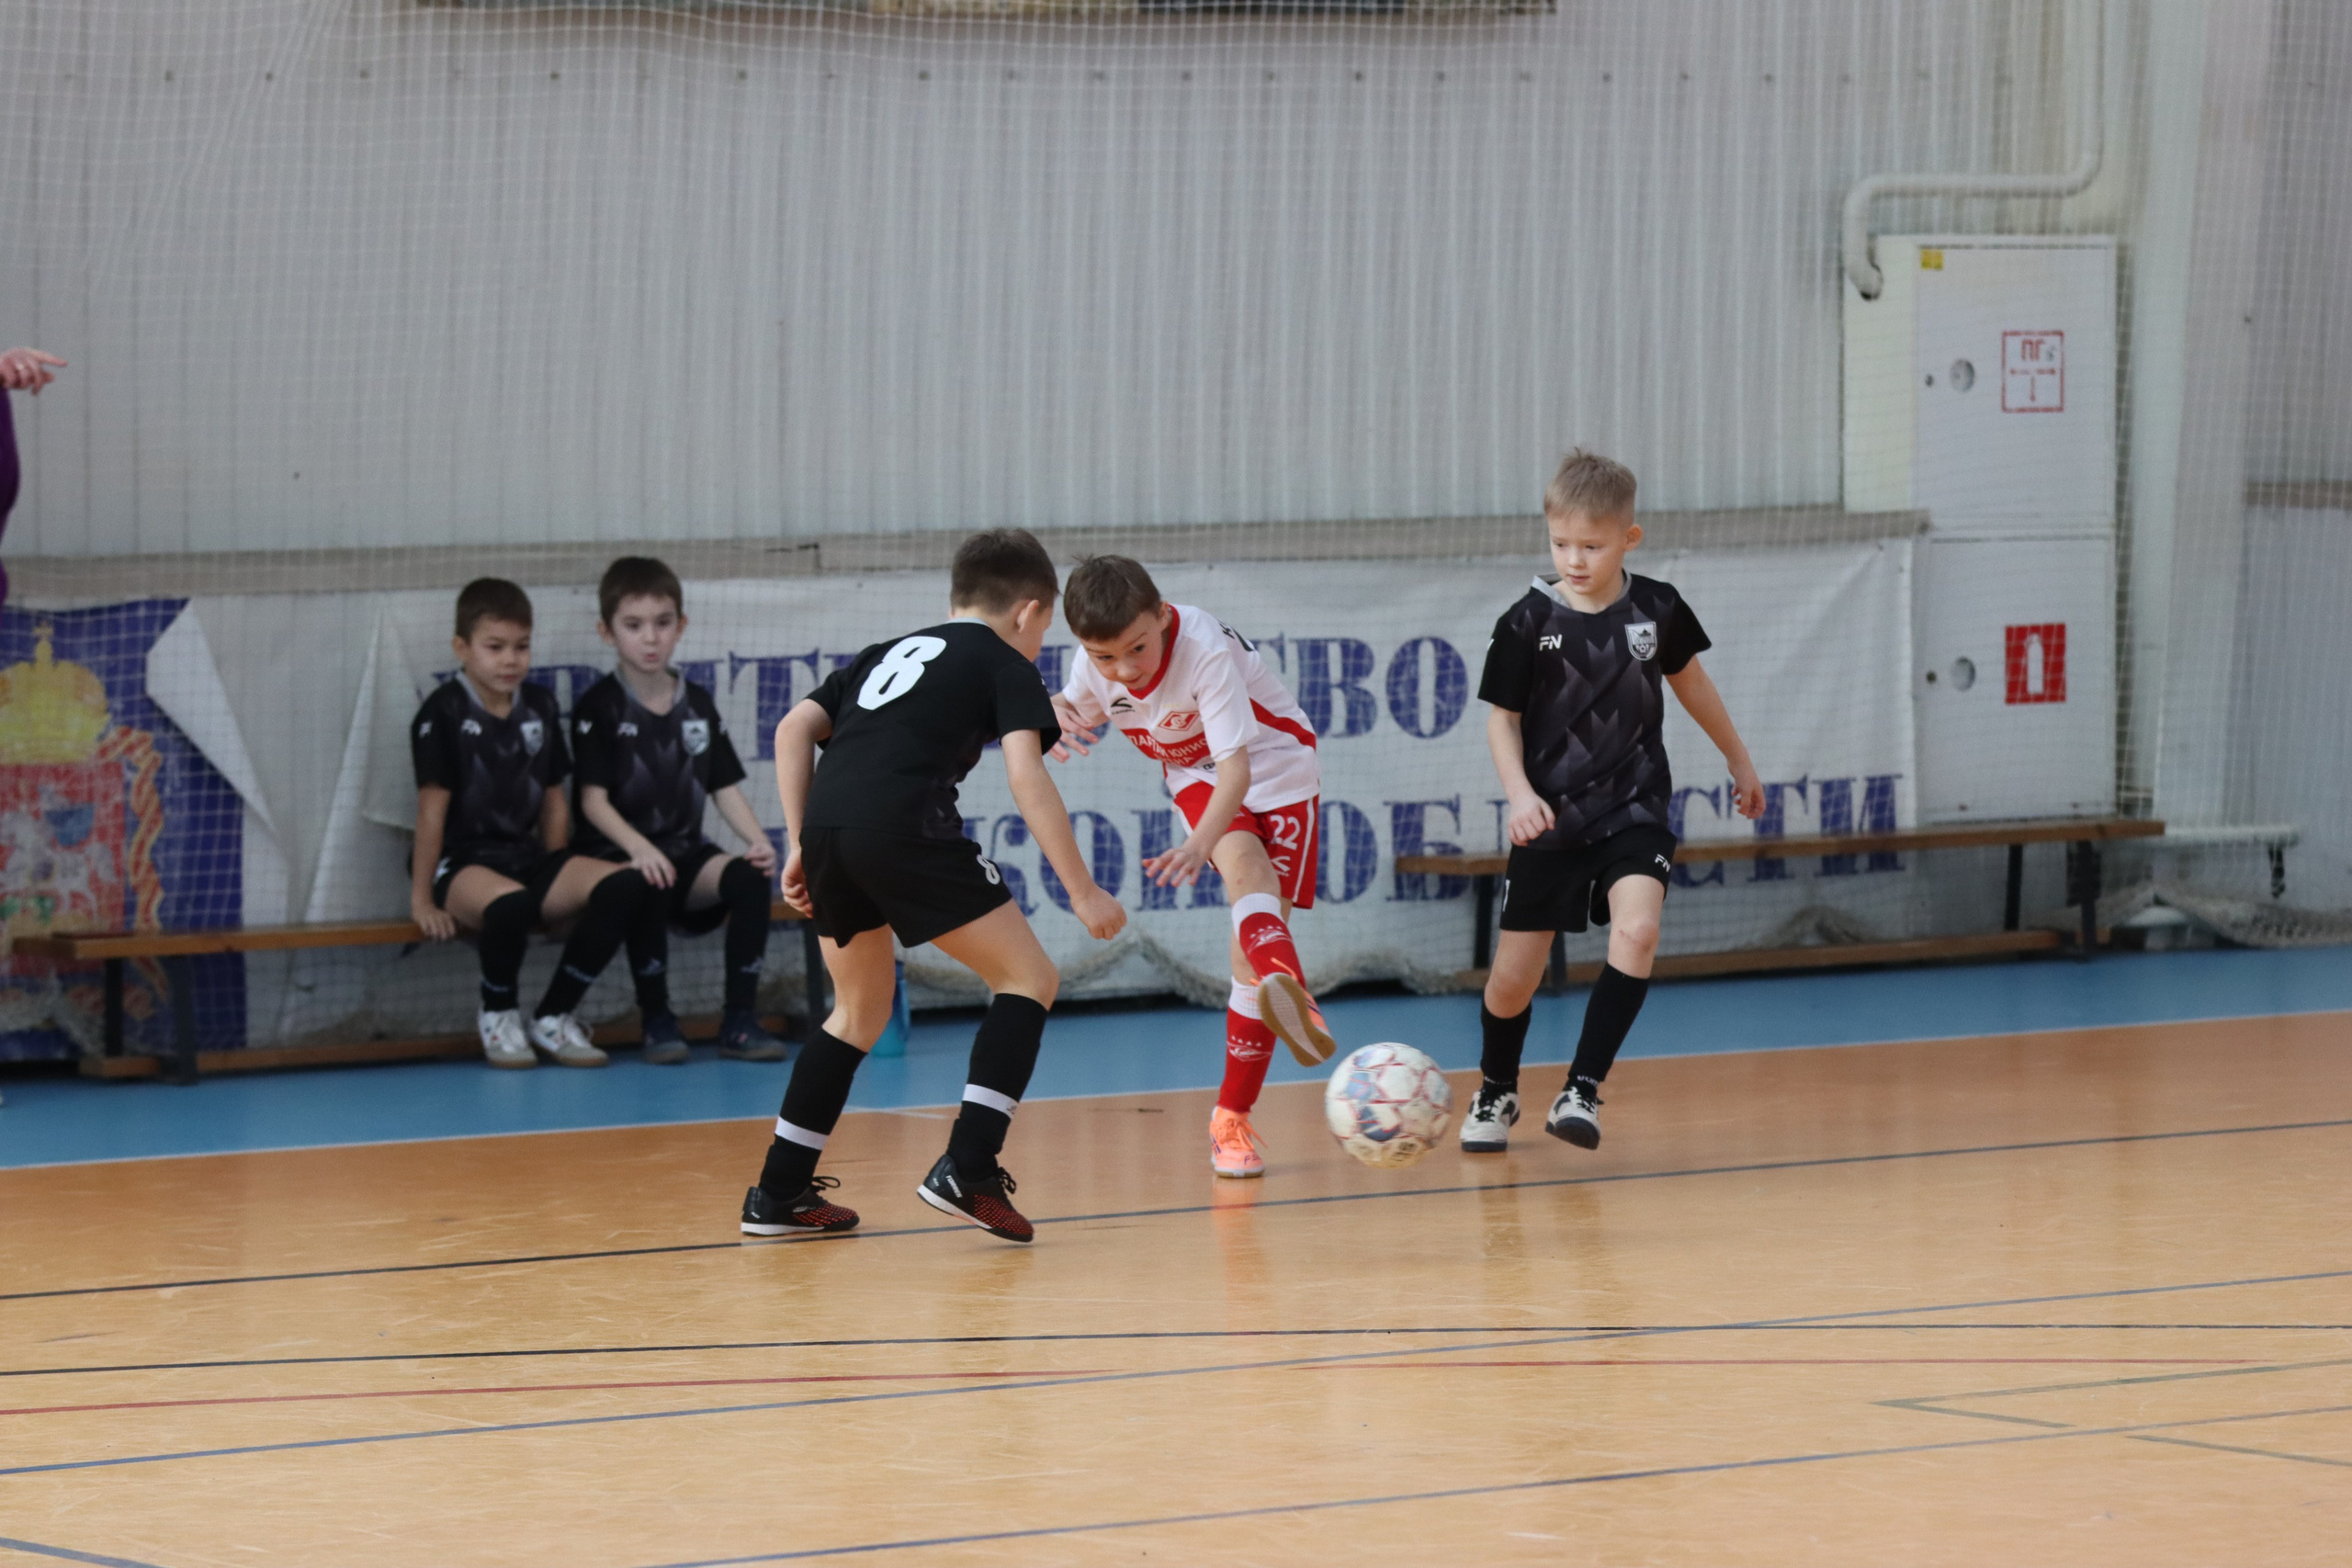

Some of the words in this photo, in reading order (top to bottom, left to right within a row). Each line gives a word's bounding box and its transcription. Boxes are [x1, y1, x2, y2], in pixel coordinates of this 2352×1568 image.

[1539, 634, 1563, 651] FN
[856, 636, 947, 711] 8
[1270, 814, 1300, 851] 22
[976, 853, 1001, 886] 8
